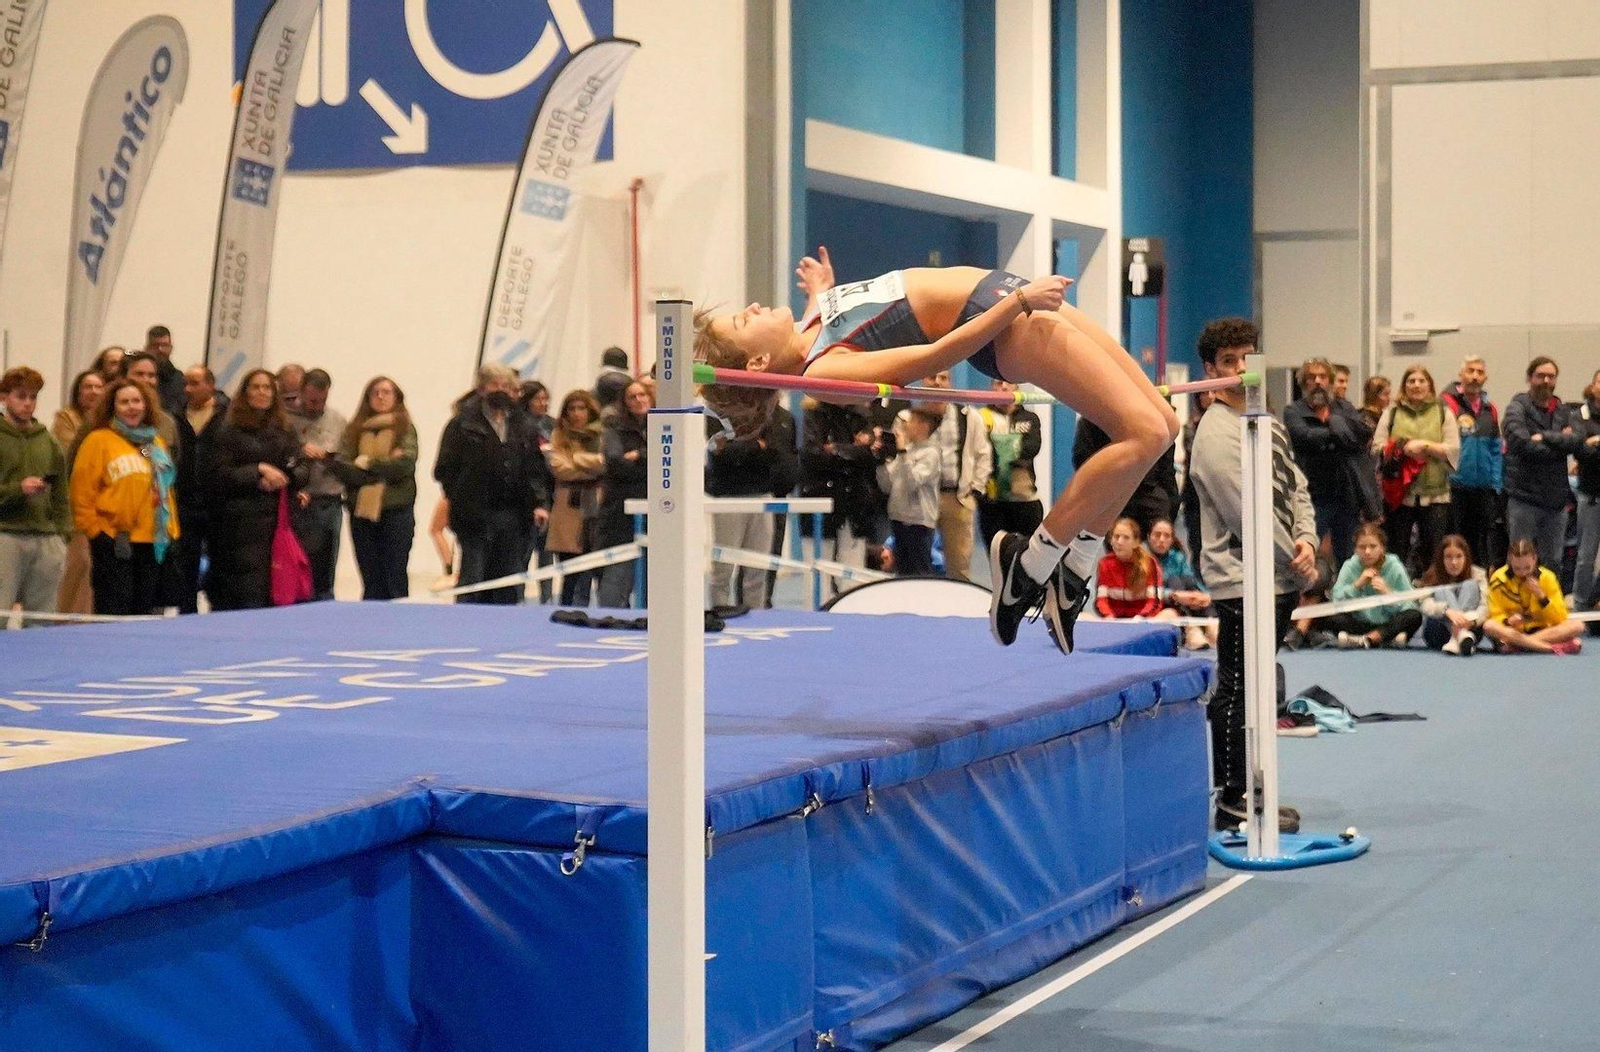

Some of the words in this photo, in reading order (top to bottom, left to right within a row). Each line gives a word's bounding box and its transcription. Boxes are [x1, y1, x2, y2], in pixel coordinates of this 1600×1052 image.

[1, 0, 27, 68] GALI
[242, 70, 267, 150] XUNTA
[264, 27, 297, 121] GALICIA
[257, 126, 275, 156] DE
[533, 108, 568, 175] XUNTA
[562, 76, 602, 152] GALICIA
[78, 46, 172, 285] Atlántico
[553, 155, 572, 180] DE
[229, 251, 248, 340] GALEGO
[497, 245, 522, 328] DEPORTE
[511, 257, 533, 331] GALEGO
[662, 325, 674, 381] MONDO
[661, 434, 673, 489] MONDO
[80, 690, 395, 725] DE
[338, 626, 833, 689] GALICA
